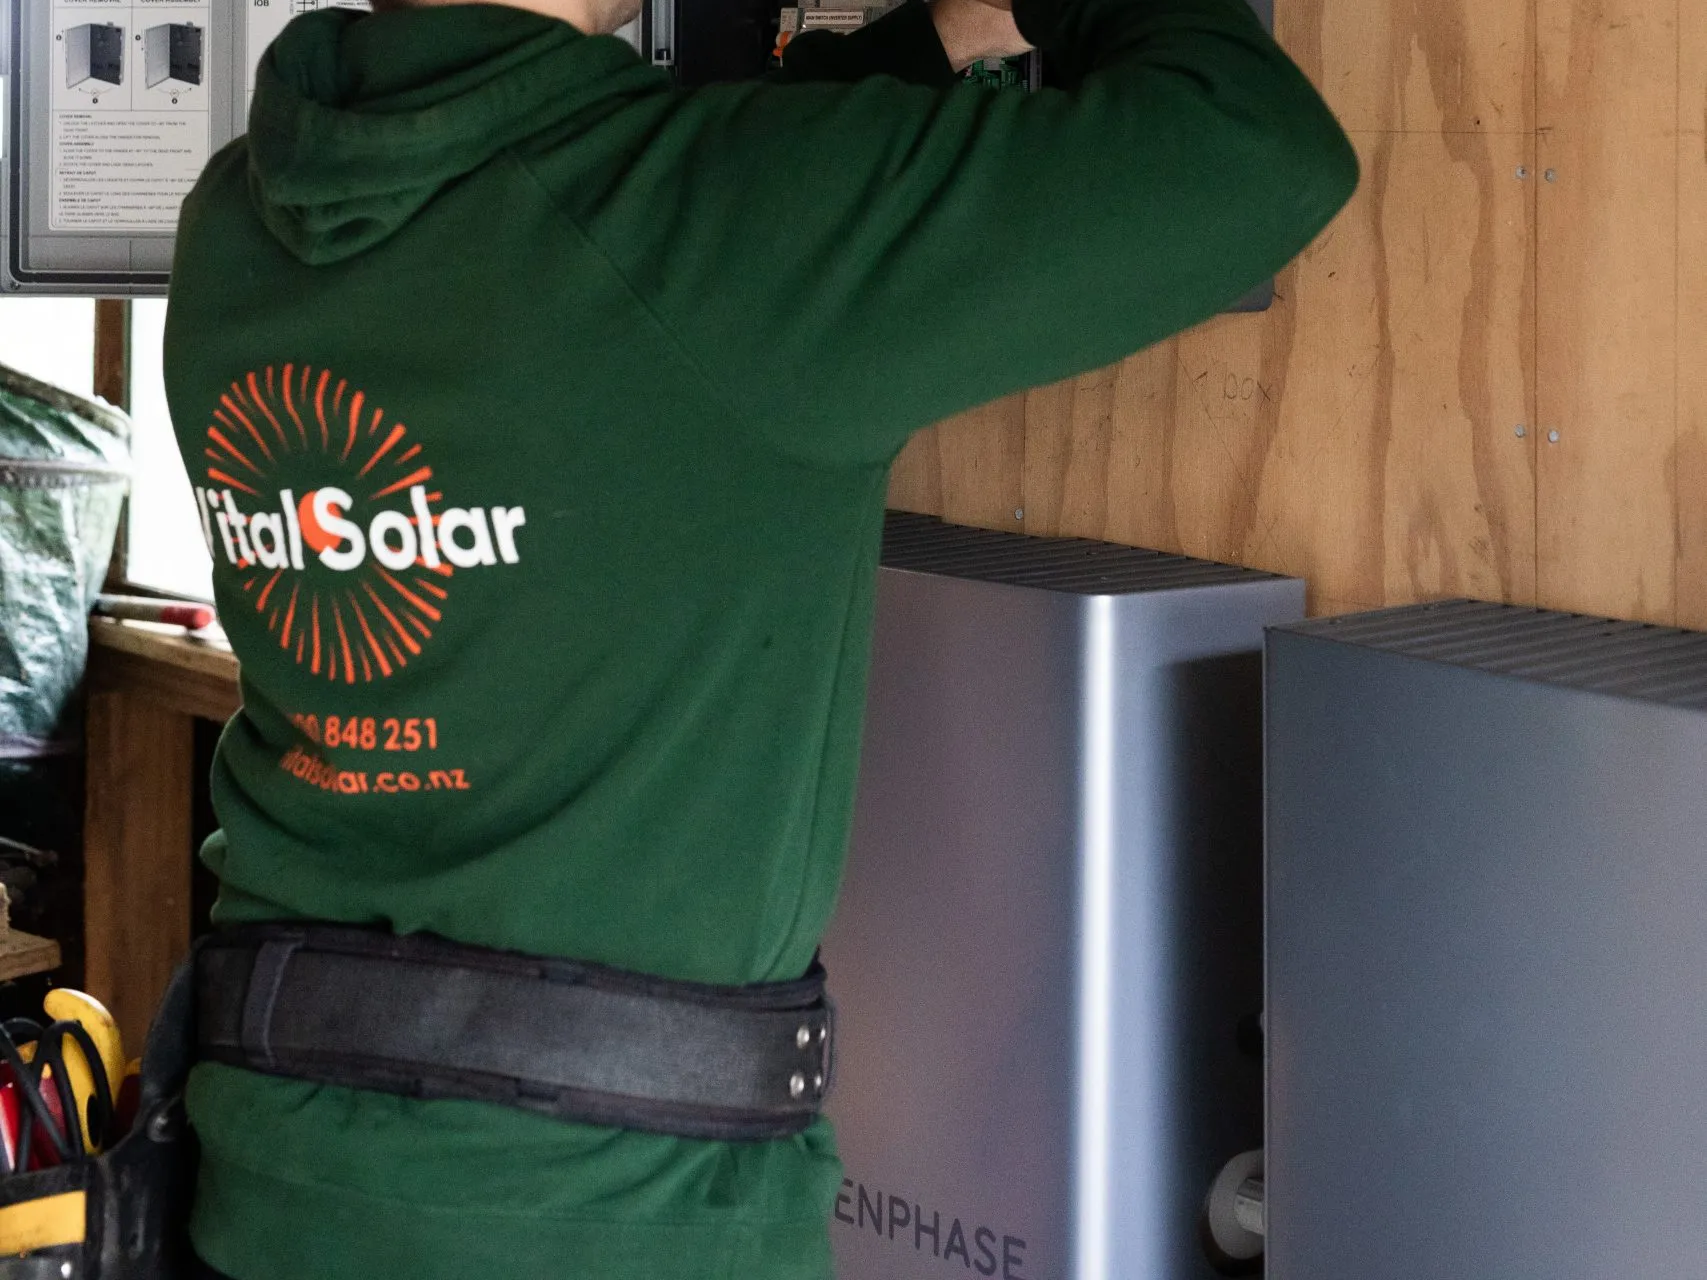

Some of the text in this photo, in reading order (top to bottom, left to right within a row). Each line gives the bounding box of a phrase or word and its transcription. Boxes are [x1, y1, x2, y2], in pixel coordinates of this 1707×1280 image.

[254, 0, 270, 7] IOB
[324, 715, 377, 750] 848
[383, 717, 438, 752] 251
[834, 1177, 1026, 1280] ENPHASE
